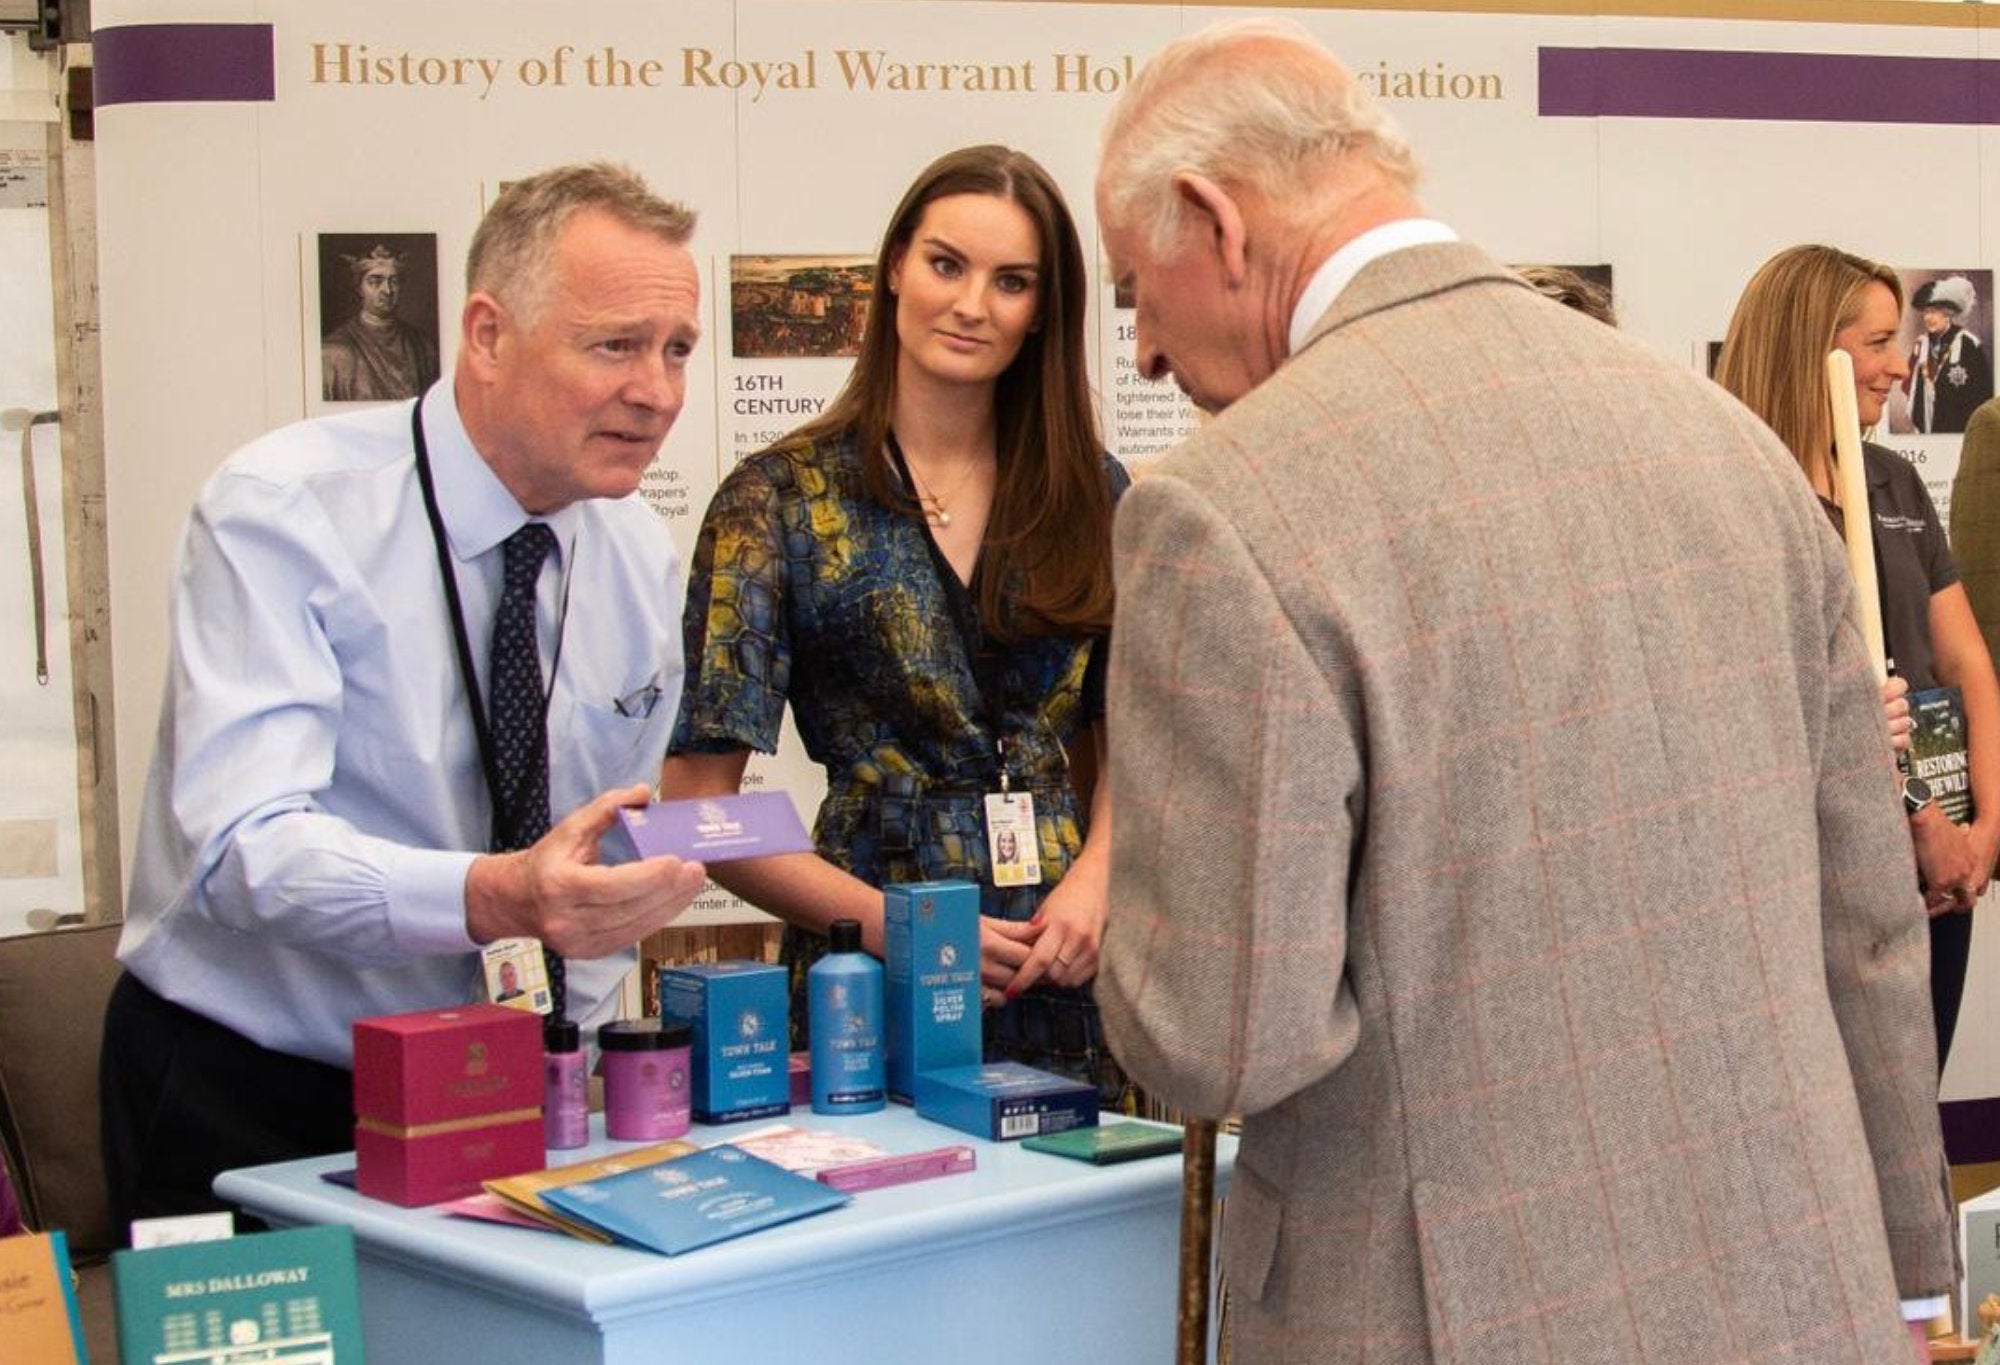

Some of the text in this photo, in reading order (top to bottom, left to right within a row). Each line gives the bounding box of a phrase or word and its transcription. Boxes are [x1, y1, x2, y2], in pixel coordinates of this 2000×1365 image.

[311, 43, 502, 100] History
[518, 45, 575, 87] of
[584, 48, 664, 87] the
[680, 48, 817, 103] Royal
[834, 50, 1036, 92] Warrant
[734, 374, 783, 391] 16TH
[733, 398, 825, 415] CENTURY
[1116, 392, 1174, 406] tightened
[1116, 408, 1143, 420] lose
[1146, 408, 1174, 420] their
[733, 430, 748, 443] In
[1116, 425, 1174, 438] Warrants
[165, 1266, 309, 1298] MRS DALLOWAY
